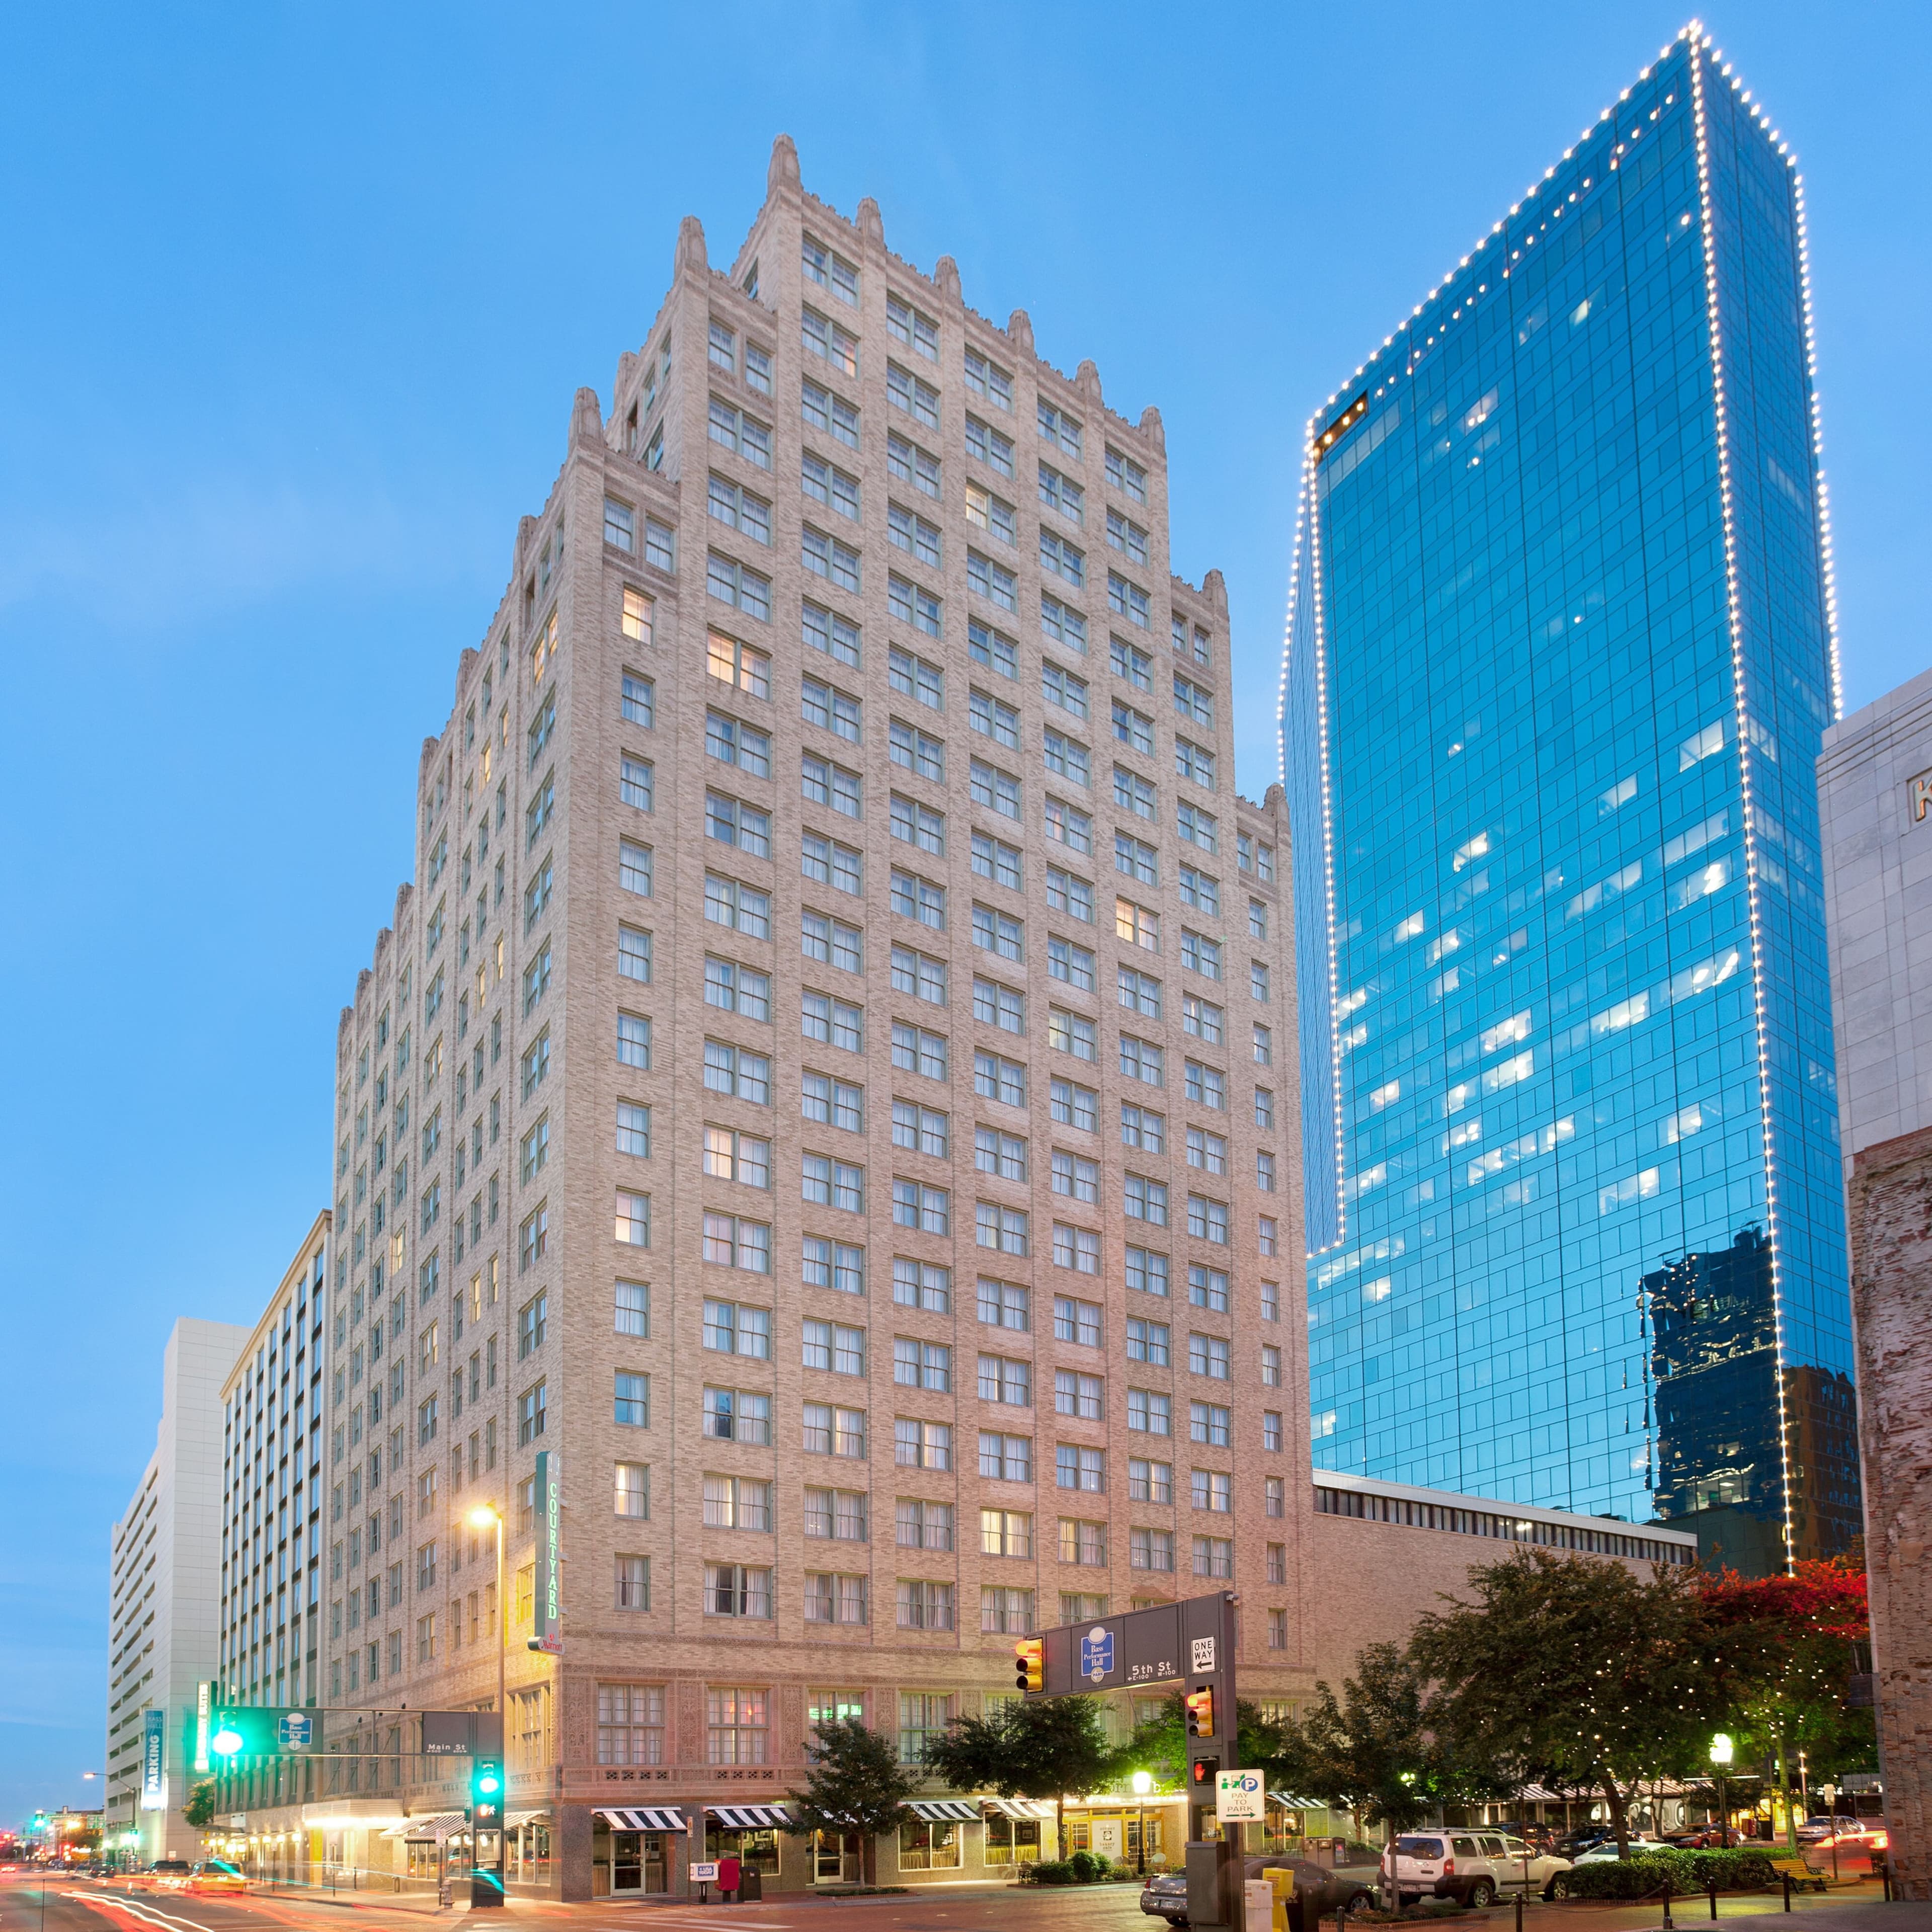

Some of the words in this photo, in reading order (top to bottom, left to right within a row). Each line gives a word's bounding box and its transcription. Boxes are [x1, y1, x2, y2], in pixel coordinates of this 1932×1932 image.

[547, 1482, 558, 1620] COURTYARD
[541, 1639, 562, 1652] Marriott
[1091, 1645, 1104, 1653] Bass
[1194, 1640, 1213, 1651] ONE
[1083, 1652, 1111, 1660] Performance
[1194, 1650, 1213, 1660] WAY
[1091, 1658, 1103, 1667] Hall
[1132, 1664, 1153, 1675] 5th
[1158, 1661, 1171, 1671] St
[147, 1734, 160, 1791] PARKING
[1245, 1779, 1256, 1790] P
